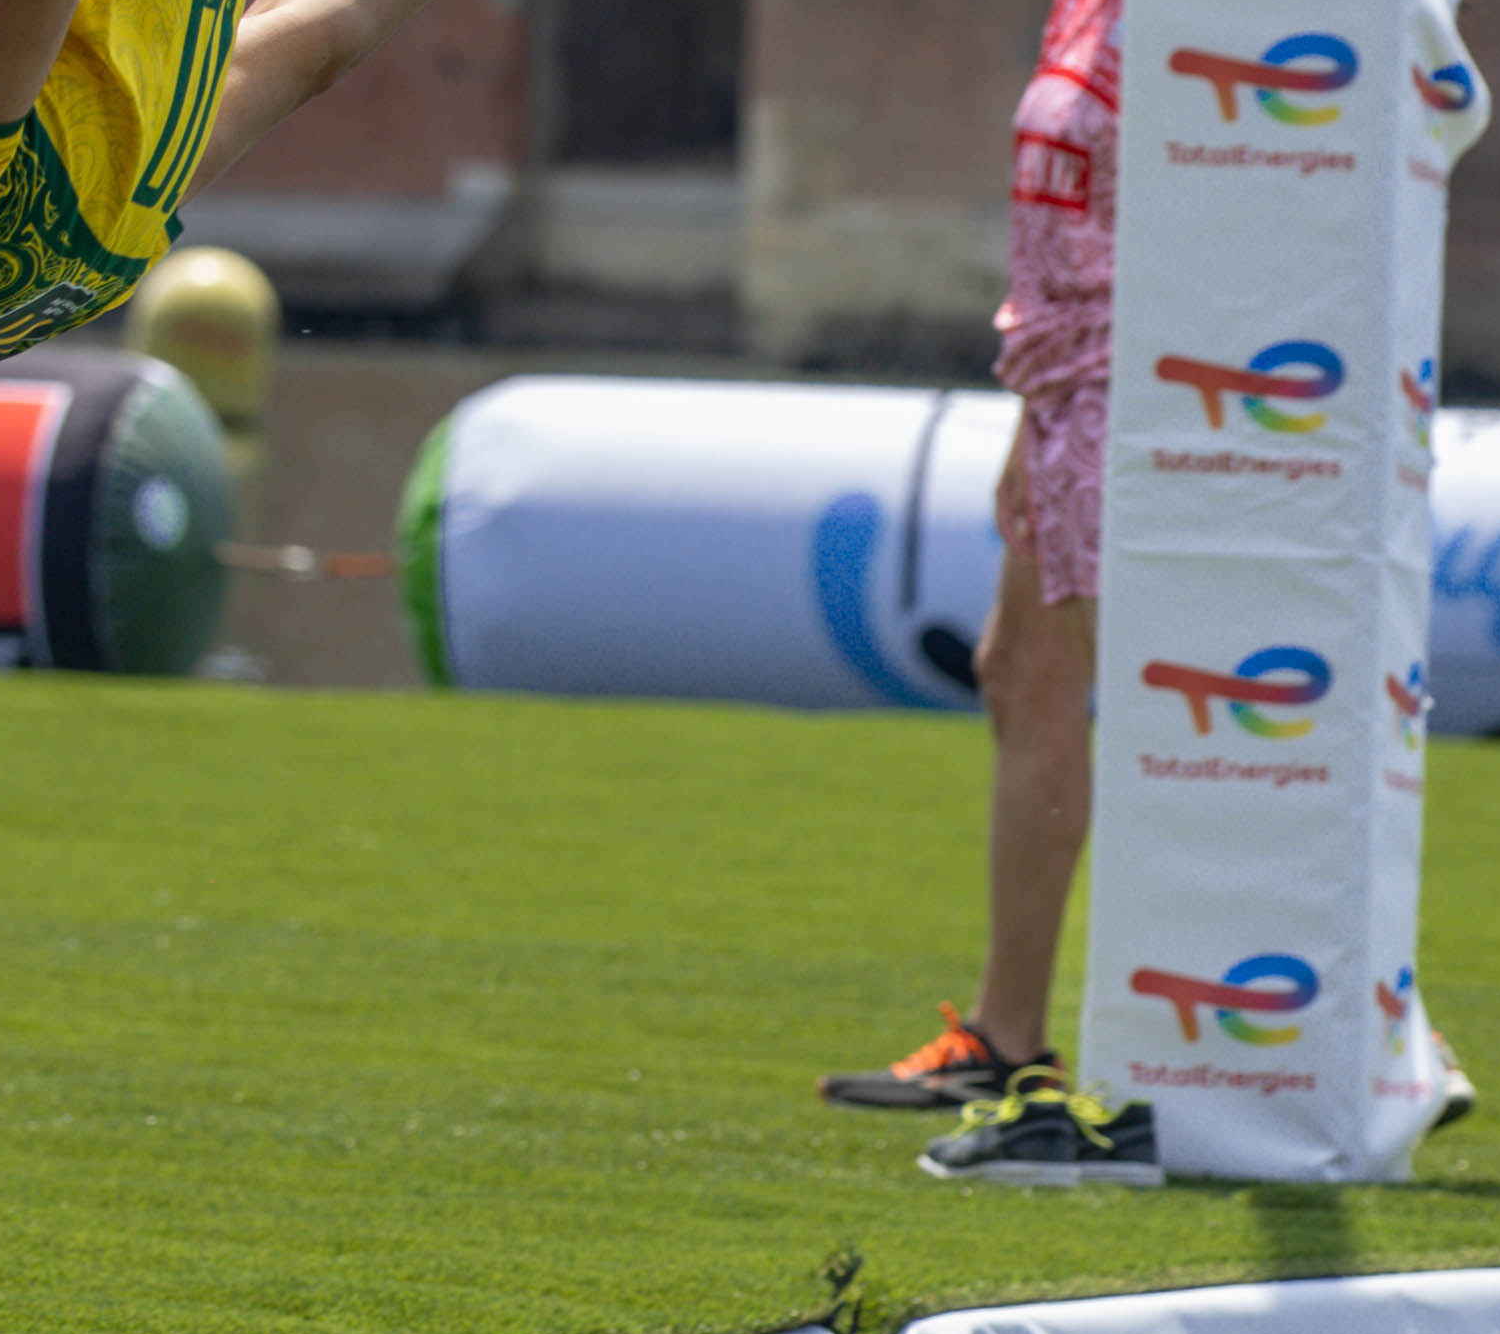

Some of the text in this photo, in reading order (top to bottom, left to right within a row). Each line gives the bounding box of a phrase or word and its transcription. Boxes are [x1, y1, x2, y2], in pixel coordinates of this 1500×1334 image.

[1164, 141, 1356, 176] TotalEnergies
[1150, 448, 1342, 482] TotalEnergies
[1139, 752, 1331, 788] TotalEnergies
[1129, 1060, 1317, 1096] TotalEnergies
